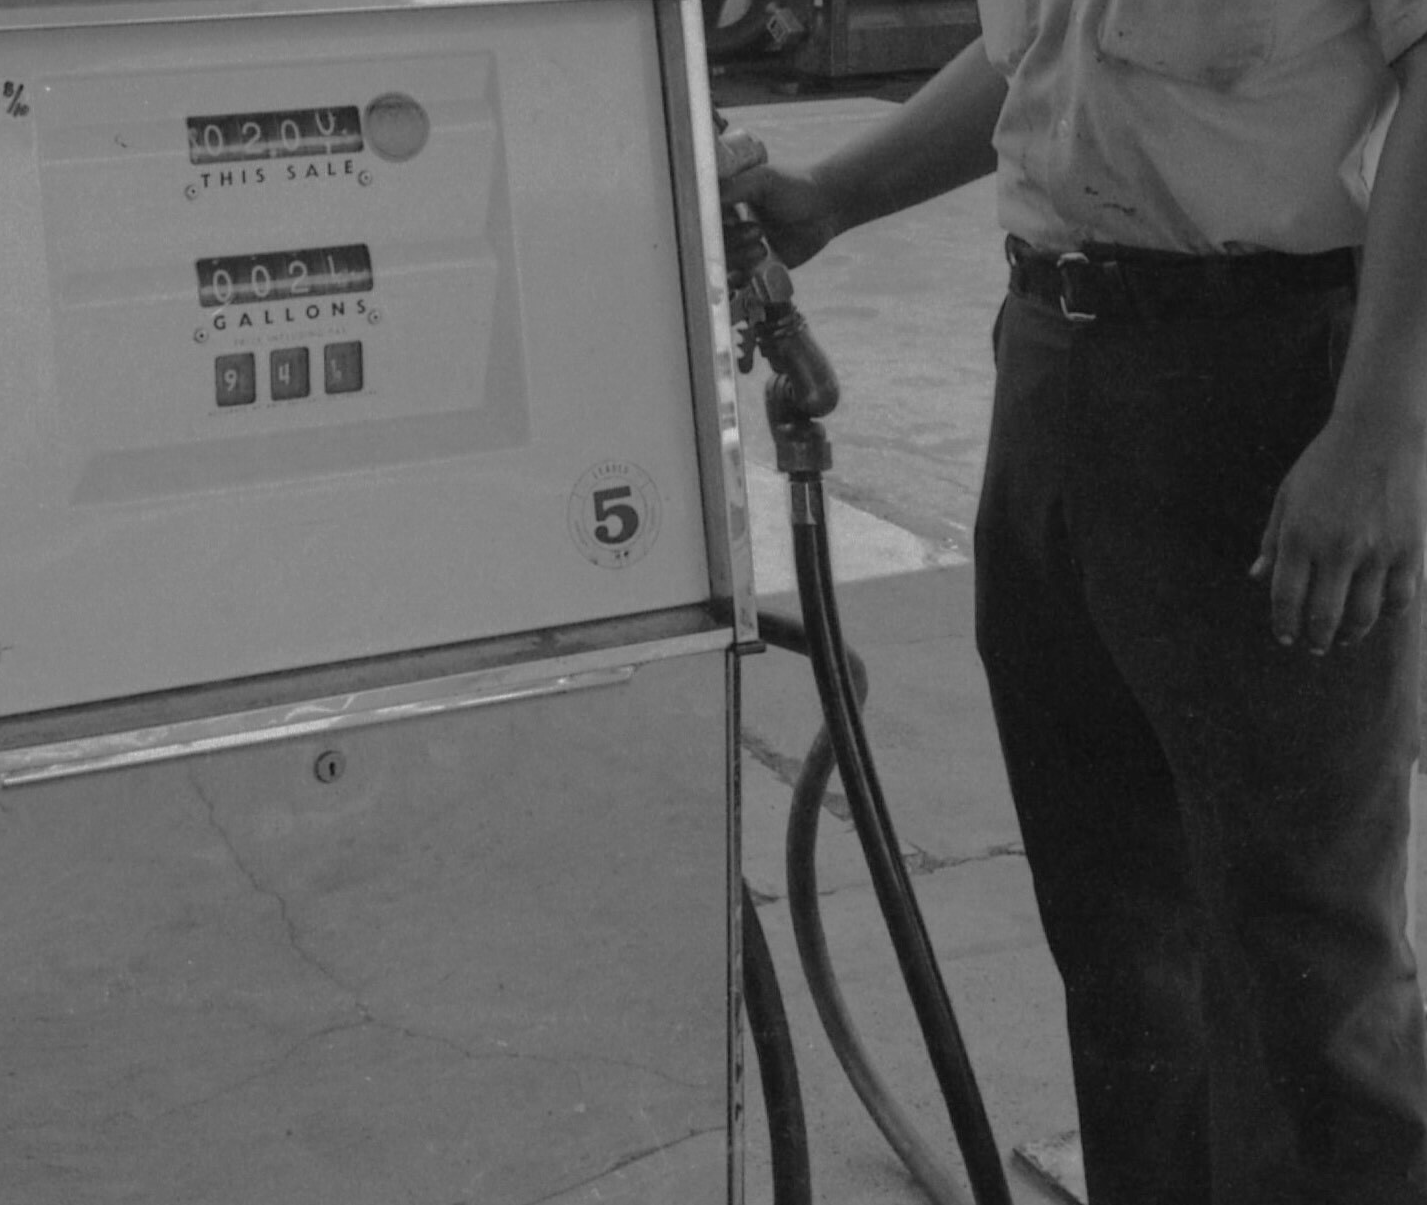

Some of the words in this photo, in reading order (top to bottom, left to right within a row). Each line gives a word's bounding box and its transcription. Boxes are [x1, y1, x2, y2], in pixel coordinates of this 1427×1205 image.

[200, 167, 266, 189] THIS
[285, 159, 355, 181] SALE
[213, 299, 367, 331] GALLONS
[592, 485, 639, 545] 5
